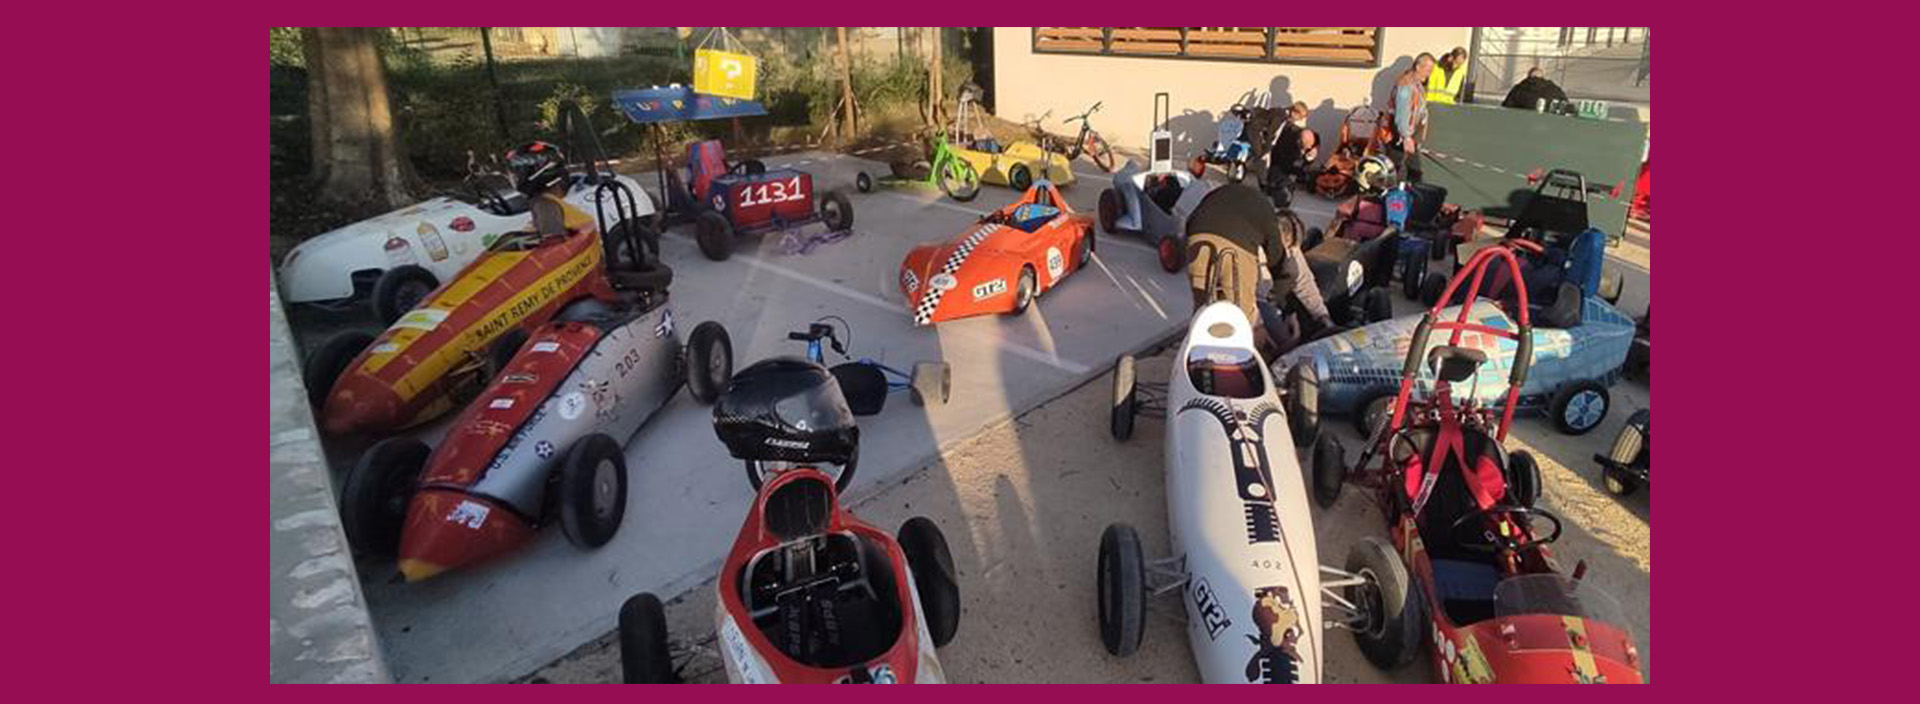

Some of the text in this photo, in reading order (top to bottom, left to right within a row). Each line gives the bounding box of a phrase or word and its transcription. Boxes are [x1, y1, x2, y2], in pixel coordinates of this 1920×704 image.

[740, 176, 805, 207] 1131
[476, 313, 509, 338] SAINT
[511, 295, 540, 318] REMY
[541, 282, 556, 298] DE
[615, 348, 641, 379] 203
[1194, 578, 1232, 641] GT2i
